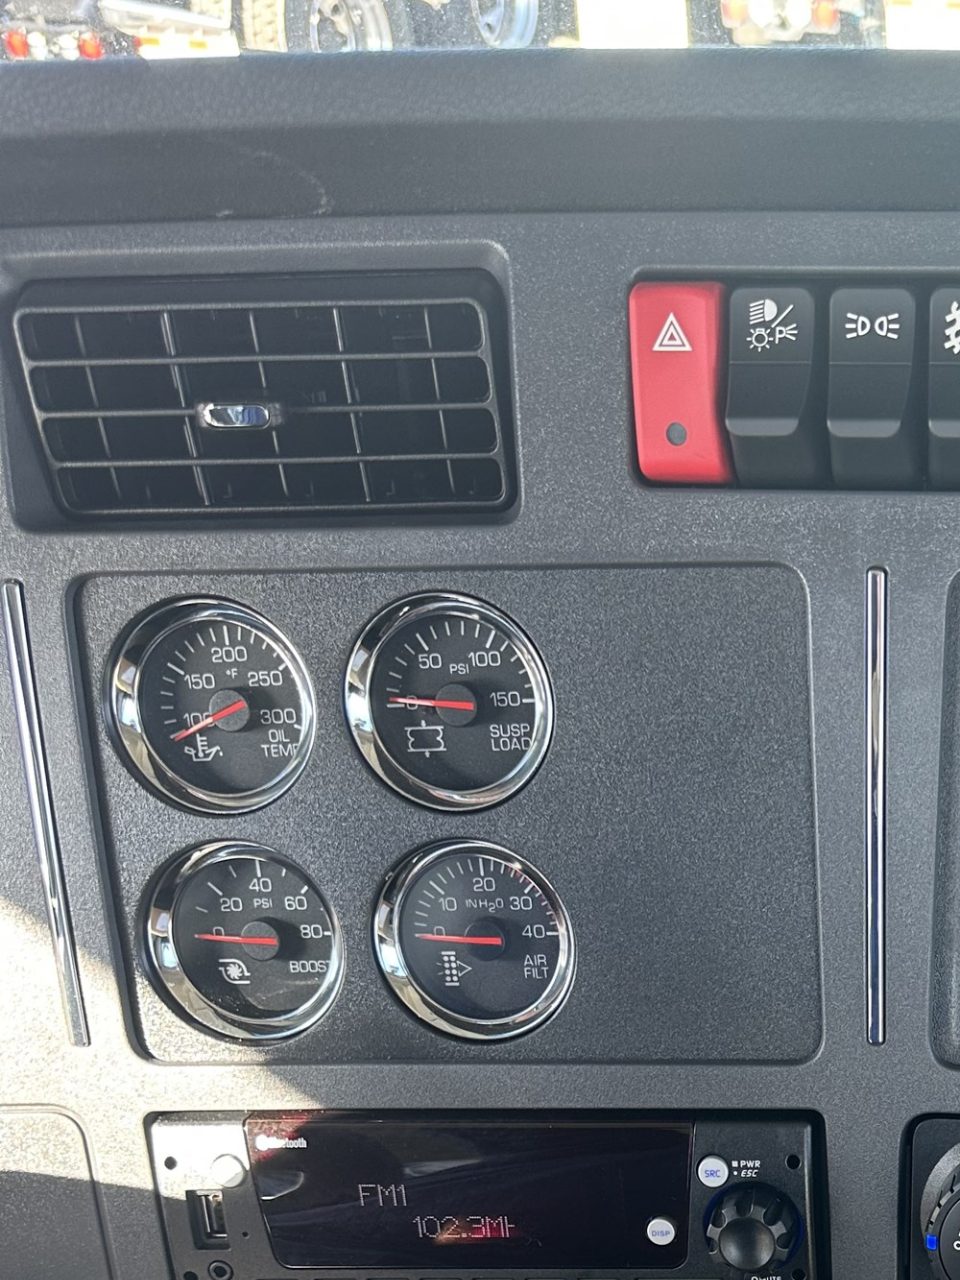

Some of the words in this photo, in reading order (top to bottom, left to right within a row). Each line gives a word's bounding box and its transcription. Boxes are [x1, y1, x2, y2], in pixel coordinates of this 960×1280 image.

[211, 646, 248, 662] 200
[418, 653, 442, 668] 50
[468, 652, 501, 667] 100
[450, 663, 470, 674] PSI
[184, 674, 215, 689] 150
[248, 670, 283, 686] 250
[490, 692, 521, 706] 150
[260, 708, 296, 724] 300
[268, 730, 290, 742] OIL
[490, 724, 530, 738] SUSP
[491, 738, 532, 751] LOAD
[249, 878, 272, 892] 40
[473, 878, 496, 892] 20
[220, 898, 243, 912] 20
[254, 898, 272, 908] PSI
[284, 896, 308, 910] 60
[438, 897, 458, 912] 10
[510, 896, 532, 910] 30
[300, 924, 323, 939] 80
[522, 924, 546, 938] 40
[290, 960, 332, 973] BOOS
[524, 954, 547, 966] AIR
[524, 966, 549, 979] FILT
[740, 1160, 761, 1168] PWR
[704, 1170, 721, 1178] SRC
[740, 1170, 758, 1178] ESC
[358, 1184, 407, 1206] FM1
